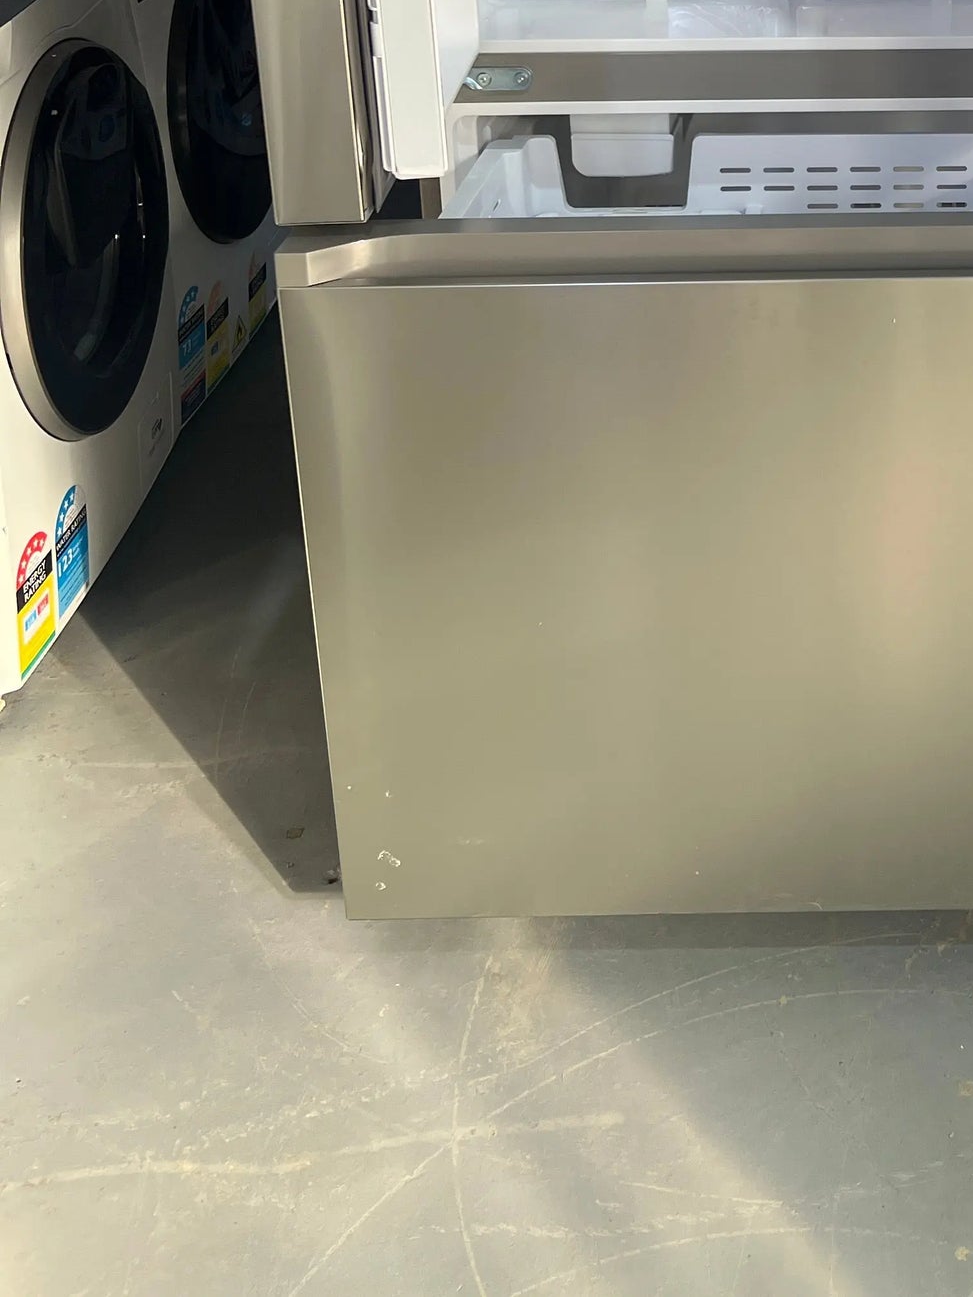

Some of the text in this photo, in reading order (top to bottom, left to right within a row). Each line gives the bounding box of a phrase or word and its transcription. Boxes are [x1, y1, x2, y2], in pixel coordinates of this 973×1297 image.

[56, 529, 71, 552] WATER
[70, 509, 87, 531] RATING
[22, 560, 47, 594] ENERGY
[24, 571, 47, 602] RATING
